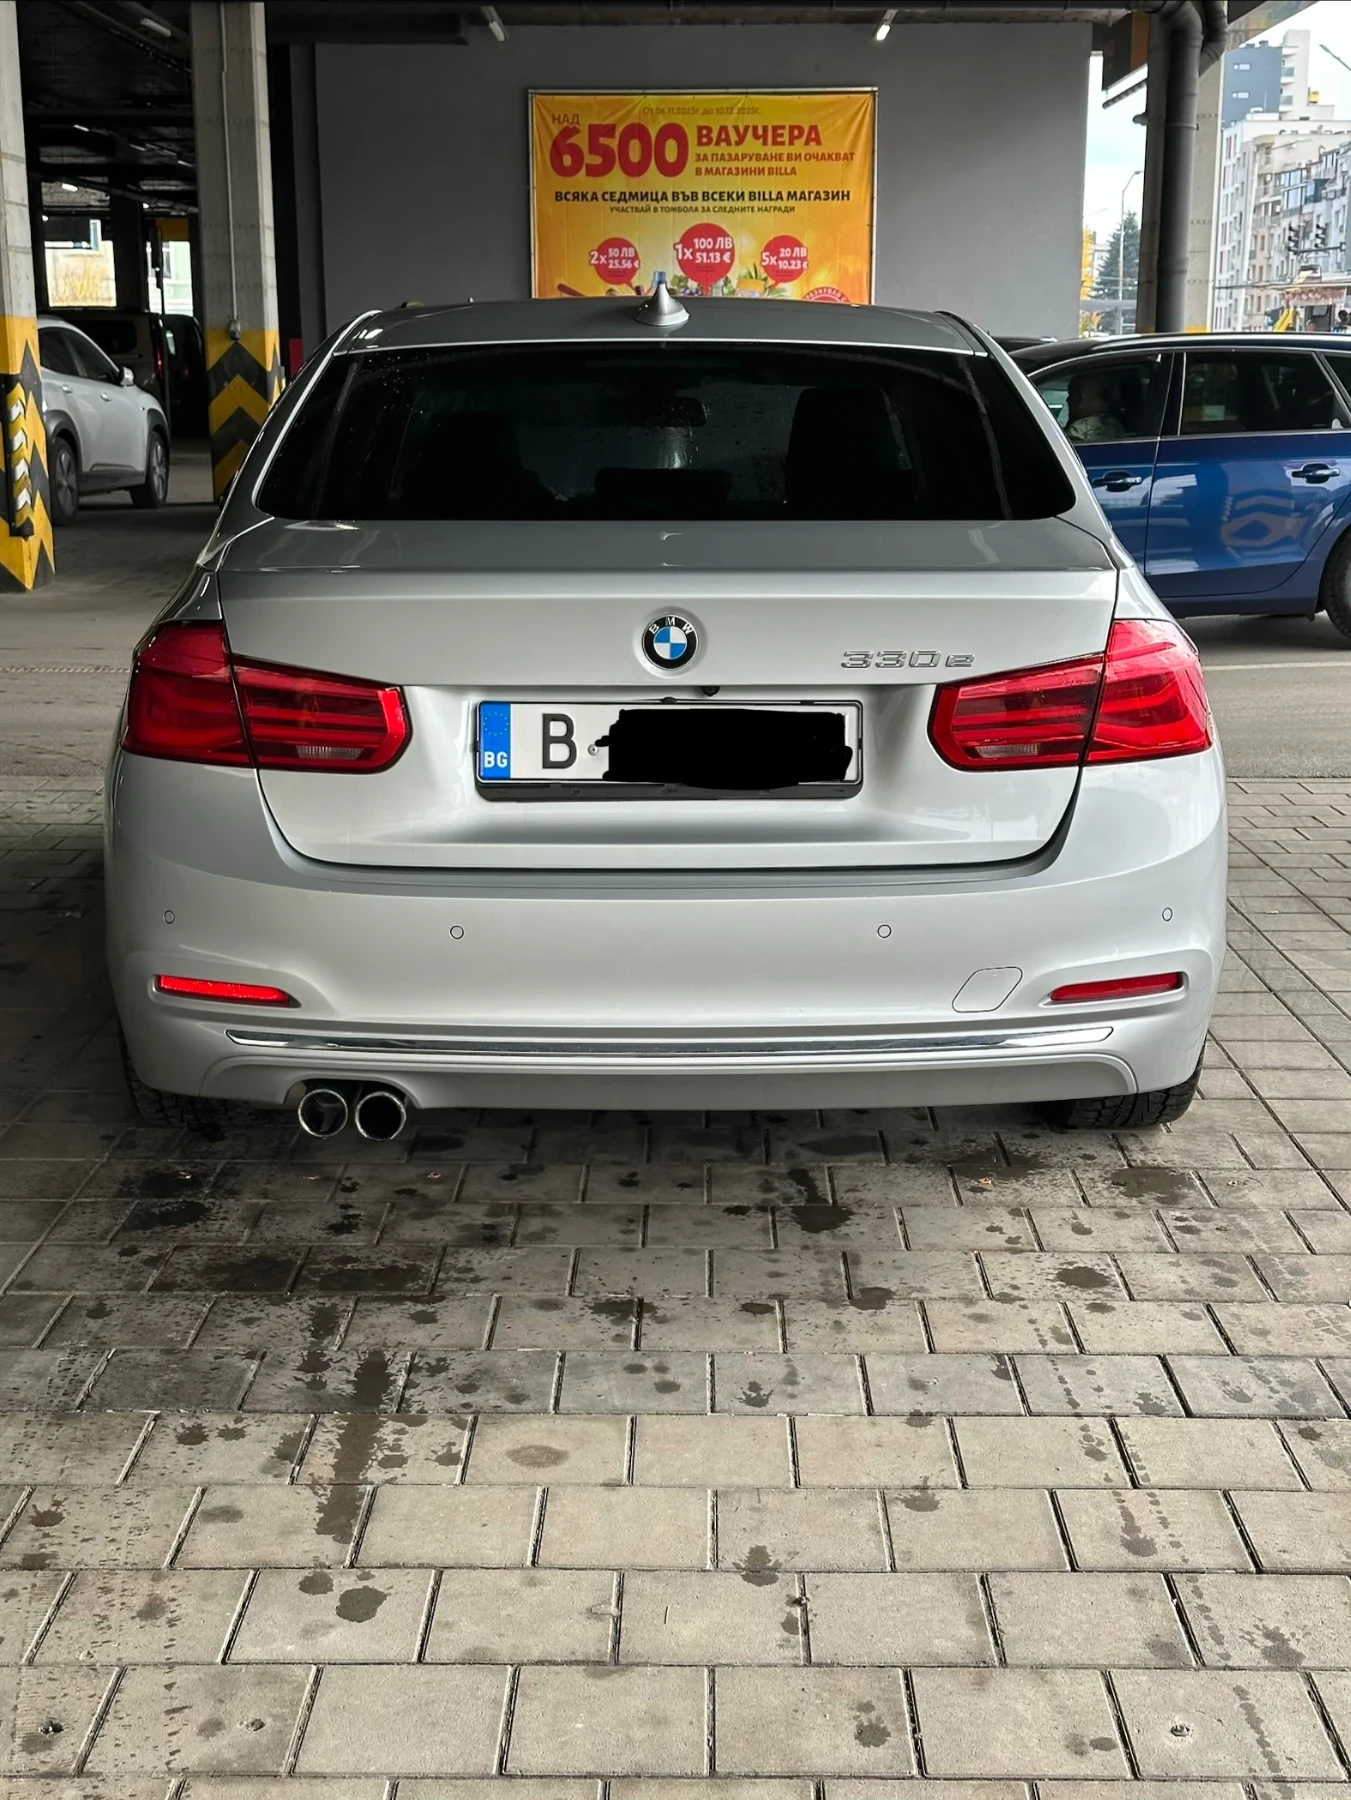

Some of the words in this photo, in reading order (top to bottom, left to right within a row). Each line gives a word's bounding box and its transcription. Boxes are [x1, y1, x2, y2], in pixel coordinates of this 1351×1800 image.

[643, 107, 654, 115] От
[702, 107, 714, 116] до
[552, 113, 580, 126] НАД
[696, 124, 823, 147] ВАУЧЕРА
[550, 122, 689, 178] 6500
[695, 152, 709, 162] ЗА
[711, 152, 785, 162] ПАЗАРУВАНЕ
[786, 152, 802, 162] ВИ
[804, 151, 855, 162] ОЧАКВАТ
[695, 166, 703, 176] В
[704, 166, 765, 176] МАГАЗИНИ
[767, 166, 797, 176] BILLA
[555, 191, 599, 202] ВСЯКА
[601, 191, 668, 204] СЕДМИЦА
[671, 191, 699, 202] ВЪВ
[702, 191, 745, 202] ВСЕКИ
[749, 190, 784, 202] BILLA
[787, 190, 851, 201] МАГАЗИН
[609, 205, 652, 213] УЧАСТВАЙ
[712, 206, 755, 214] СЛЕДНИТЕ
[757, 205, 795, 214] НАГРАДИ
[693, 238, 714, 249] 100
[715, 237, 733, 249] ЛВ
[608, 248, 620, 257] 50
[620, 248, 635, 257] ЛВ
[696, 252, 721, 264] 51.13
[722, 252, 731, 263] €
[779, 248, 791, 257] 20
[792, 247, 807, 257] ЛВ
[608, 260, 632, 269] 25.56
[633, 260, 640, 269] €
[778, 260, 802, 270] 10.23
[802, 260, 808, 269] €
[647, 616, 694, 636] BMW
[841, 650, 976, 669] 330e
[484, 751, 508, 768] BG
